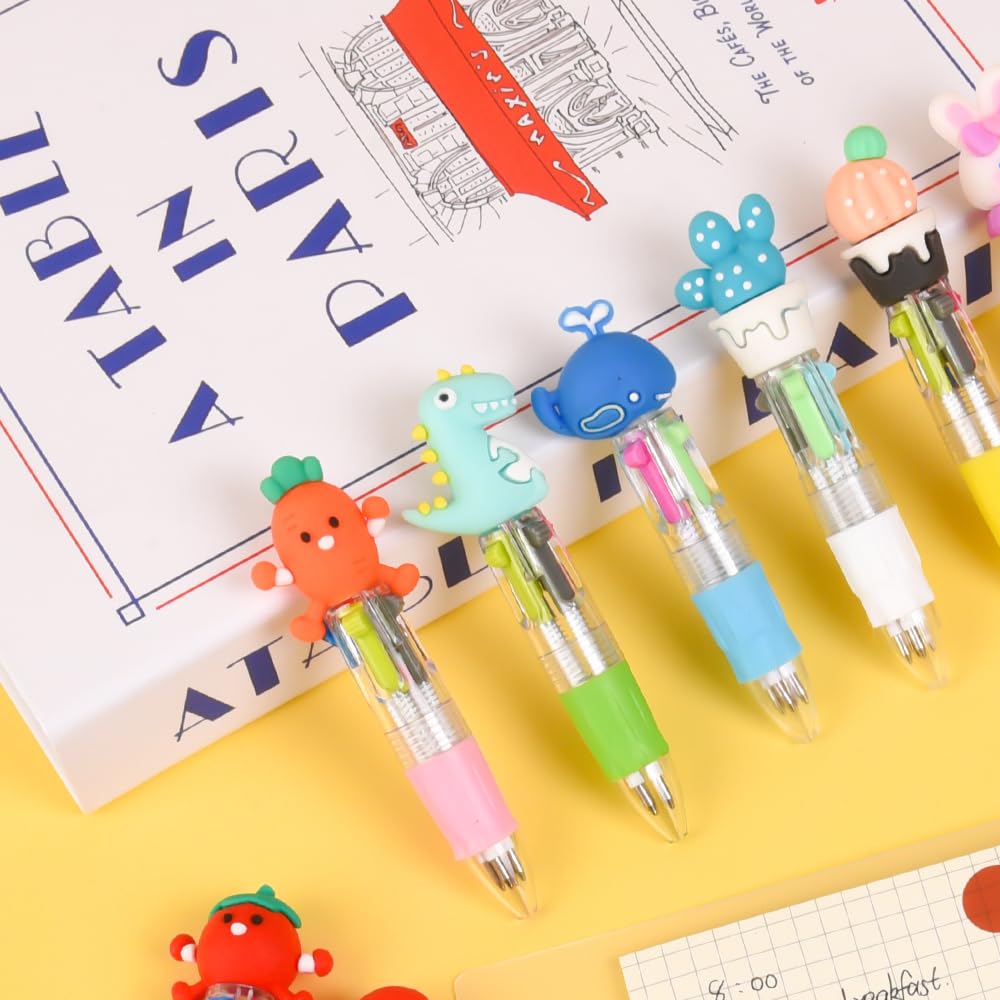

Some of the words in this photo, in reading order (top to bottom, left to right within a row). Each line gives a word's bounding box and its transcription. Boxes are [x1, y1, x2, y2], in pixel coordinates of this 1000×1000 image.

[770, 39, 798, 65] THE
[751, 71, 780, 105] THE
[793, 70, 815, 86] OF
[157, 29, 418, 348] PARIS
[136, 186, 237, 283] IN
[169, 380, 244, 444] A
